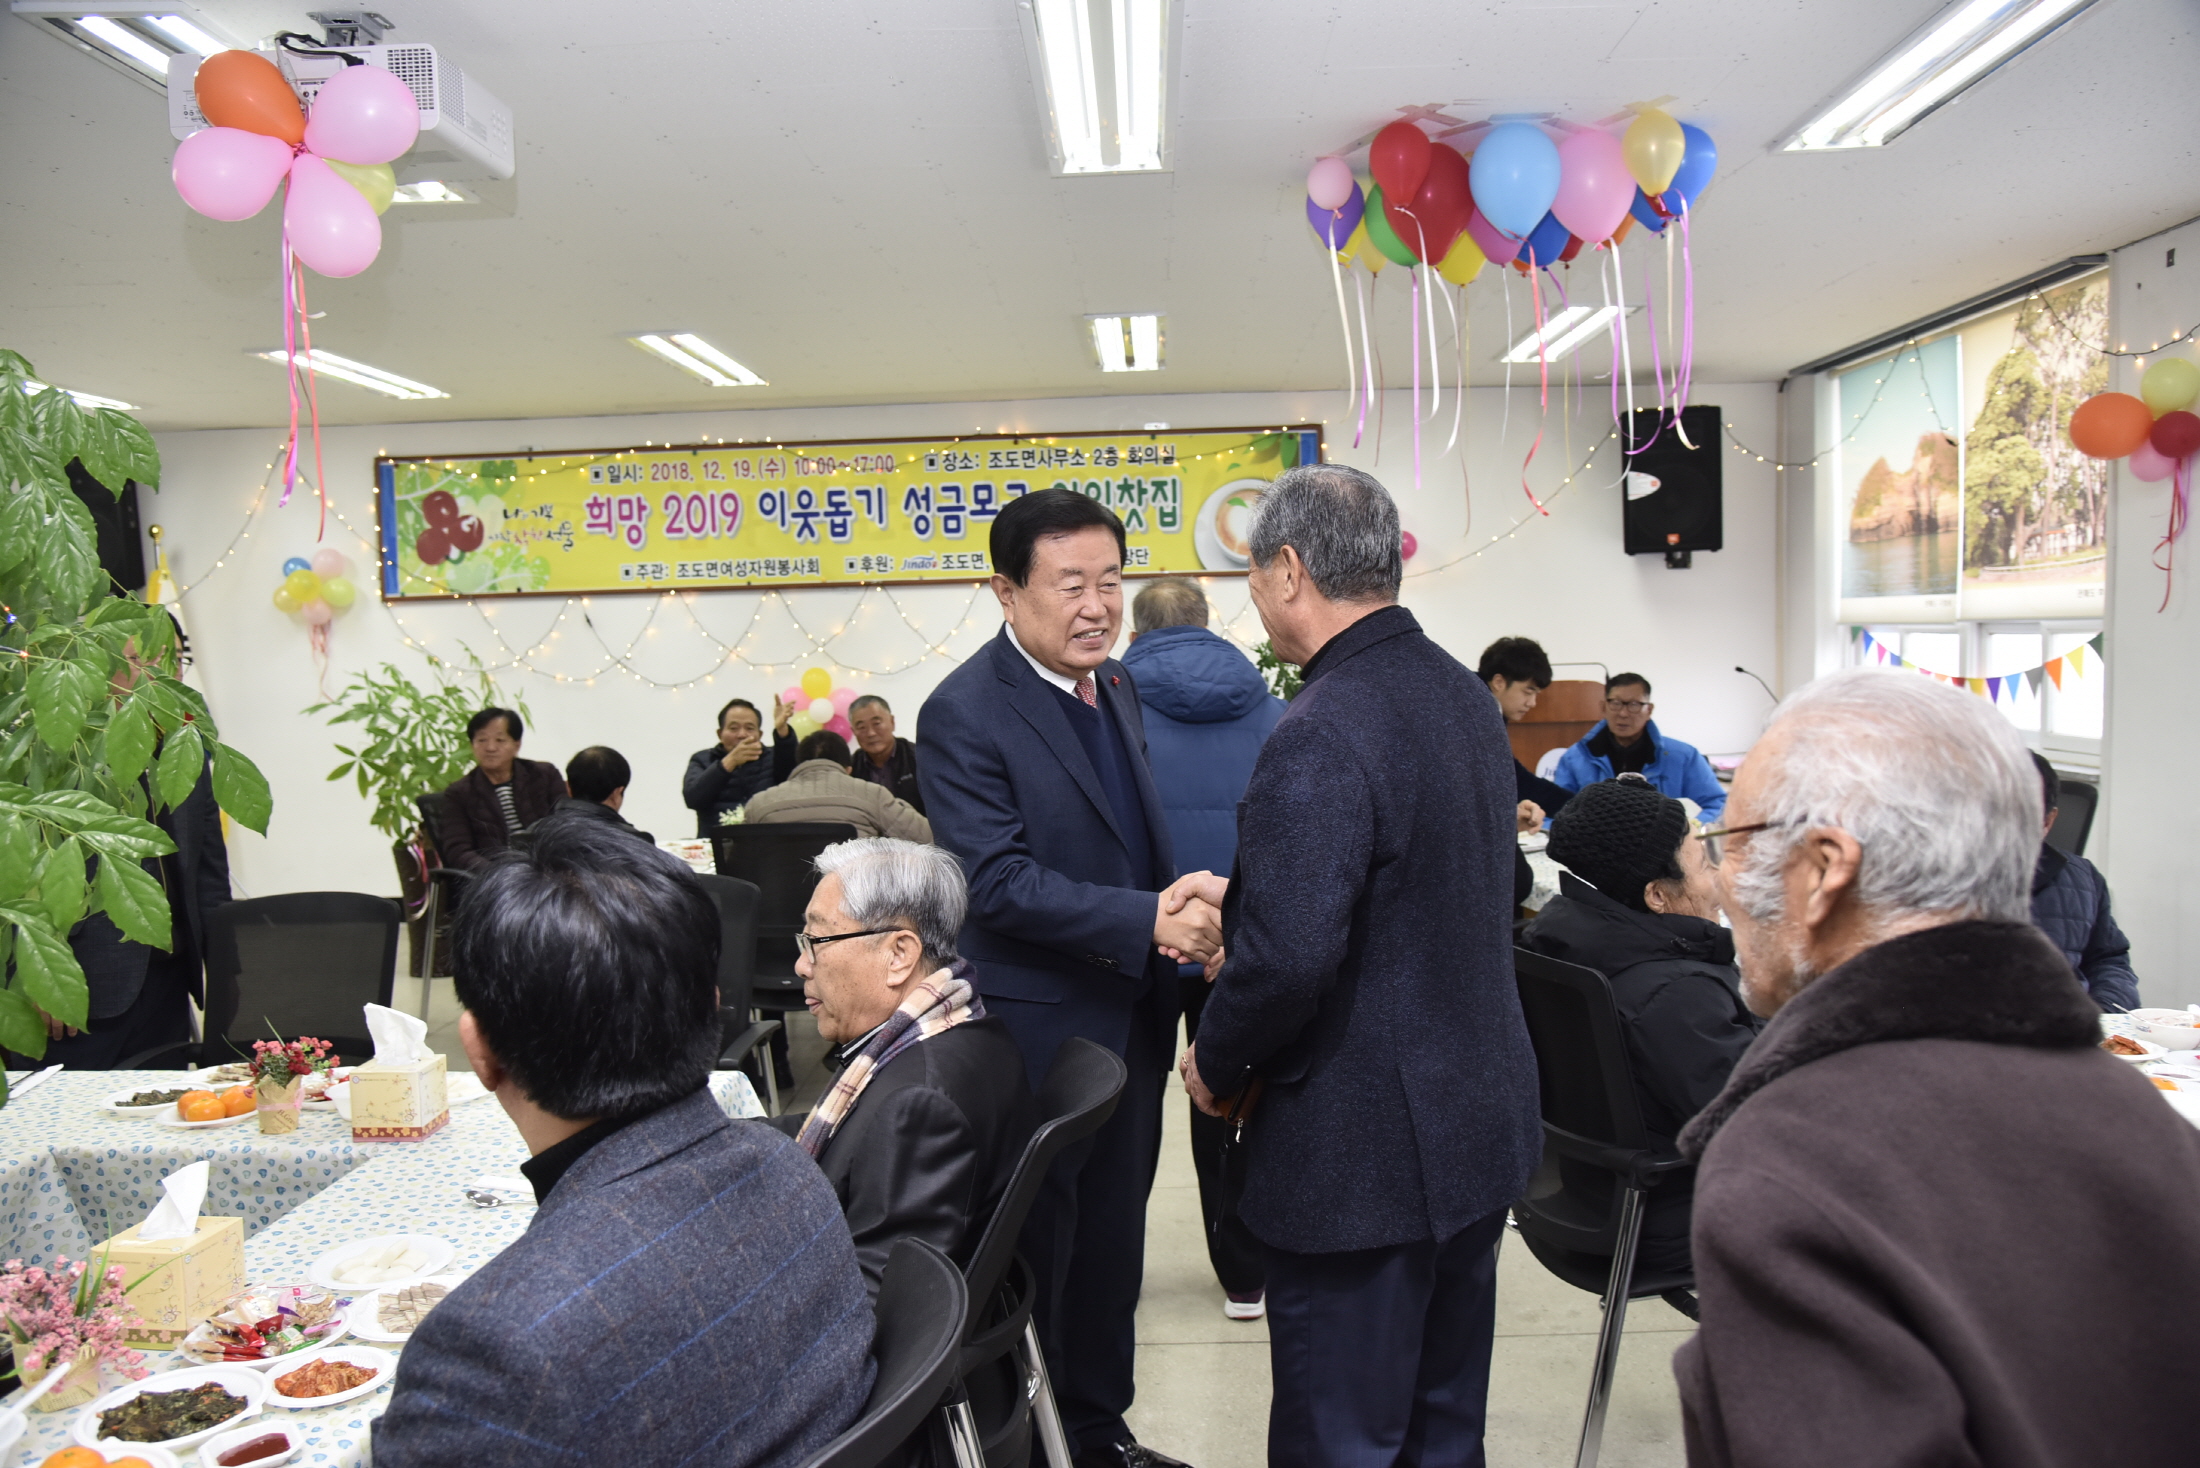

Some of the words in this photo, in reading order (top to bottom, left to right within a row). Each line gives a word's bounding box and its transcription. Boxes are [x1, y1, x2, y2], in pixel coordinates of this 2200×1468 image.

[942, 453, 980, 472] 장소:
[988, 448, 1086, 469] 조도면사무소
[1094, 448, 1118, 467] 2층
[1127, 445, 1175, 466] 회의실
[607, 464, 643, 484] 일시:
[651, 461, 694, 481] 2018.
[703, 461, 726, 480] 12.
[586, 495, 648, 546] 희망
[664, 492, 740, 535] 2019
[758, 487, 885, 538] 이웃돕기
[1053, 477, 1178, 529] 찻집
[637, 562, 669, 580] 주관:
[677, 558, 821, 579] 조도면여성자원봉사회
[860, 554, 894, 573] 후원:
[901, 557, 933, 571] Jindo
[941, 552, 990, 571] 조도면,
